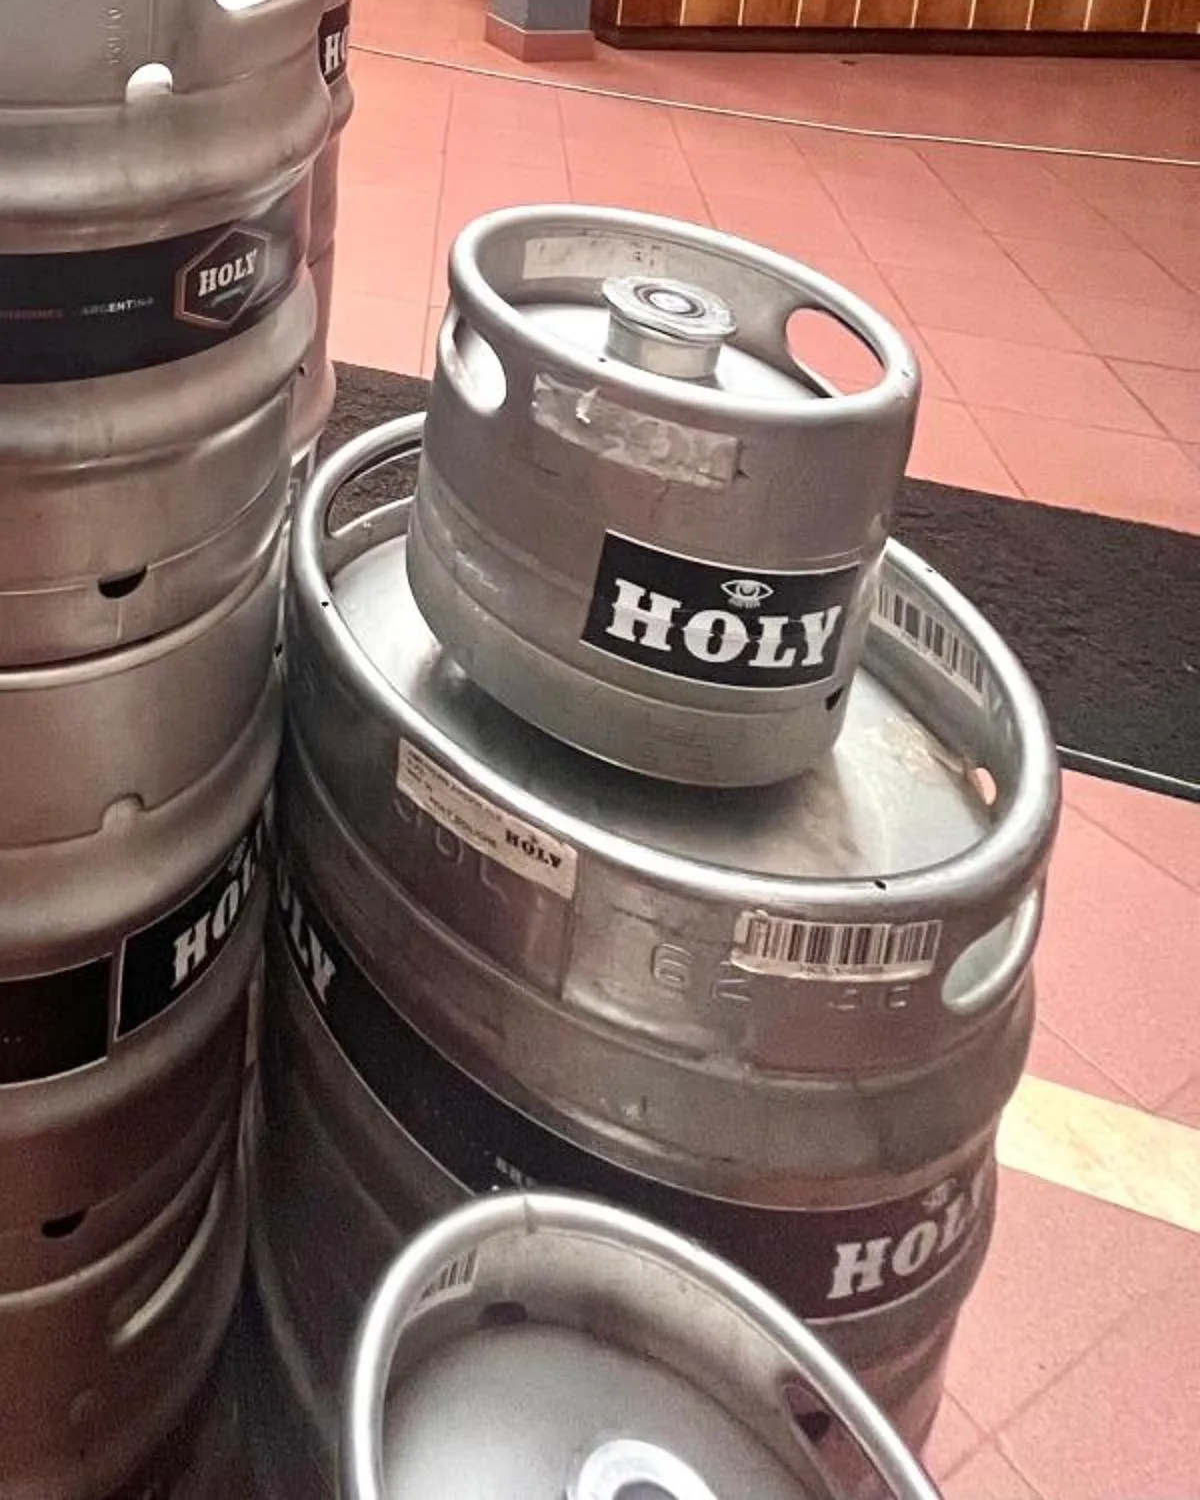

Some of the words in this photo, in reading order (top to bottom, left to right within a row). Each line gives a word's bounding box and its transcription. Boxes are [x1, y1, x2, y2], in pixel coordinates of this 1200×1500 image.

[198, 247, 259, 298] HOLY
[606, 577, 843, 669] HOLY
[505, 828, 562, 870] HOLY
